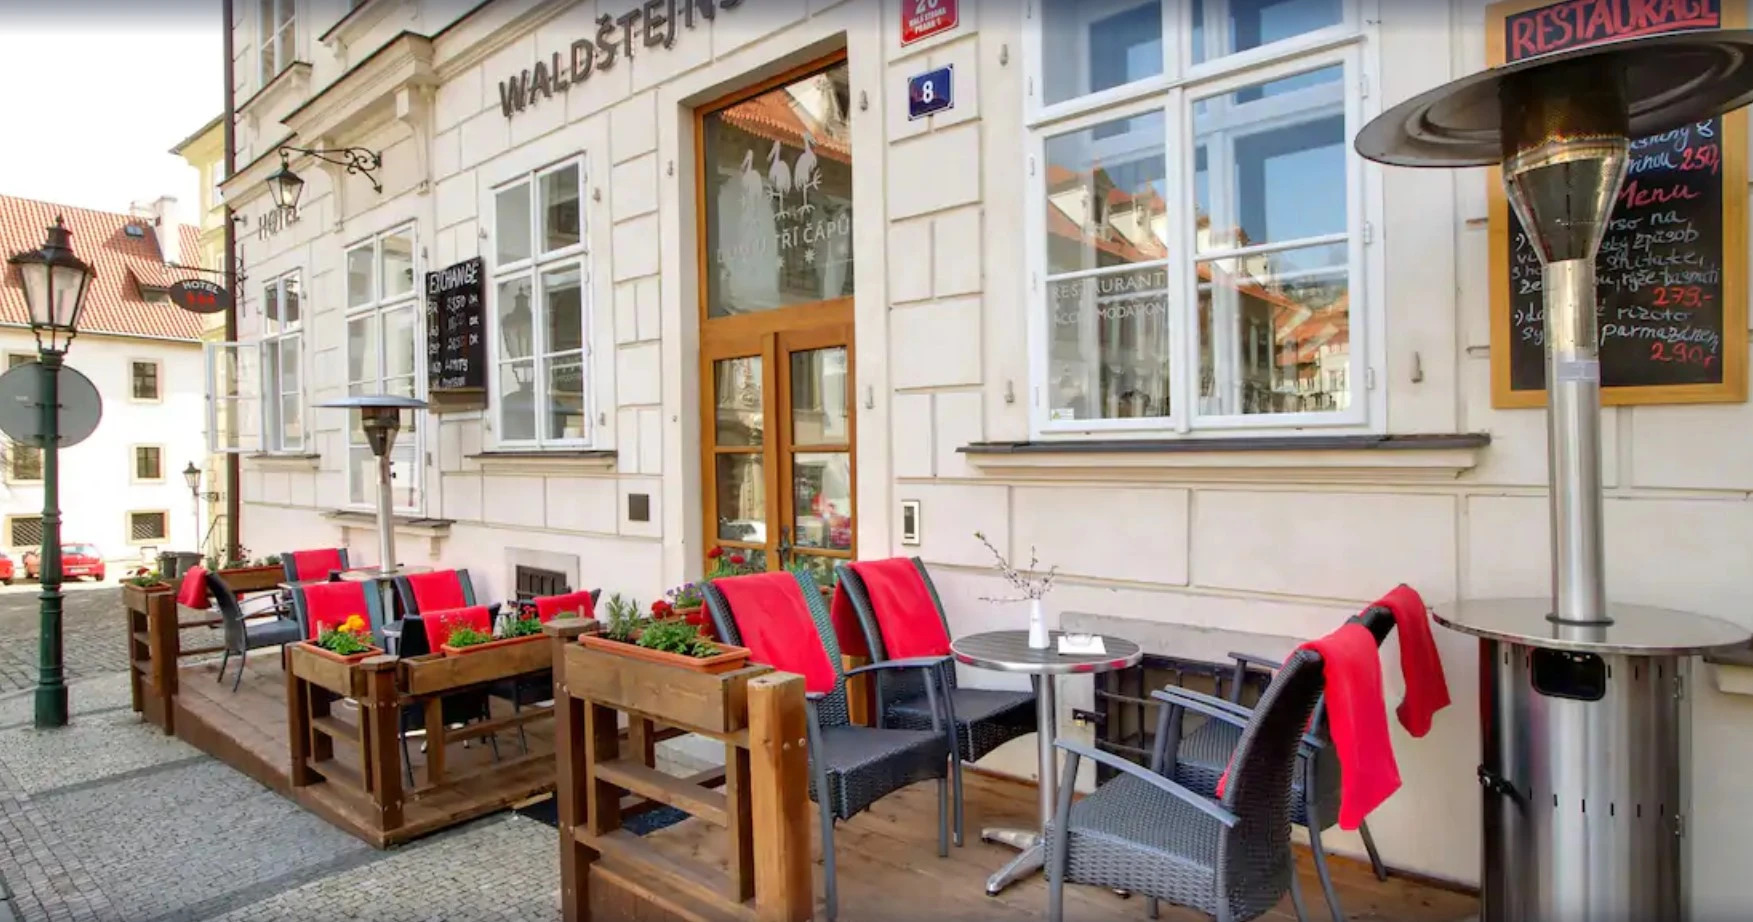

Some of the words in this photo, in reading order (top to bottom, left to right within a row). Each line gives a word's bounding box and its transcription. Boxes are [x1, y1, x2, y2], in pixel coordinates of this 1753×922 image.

[922, 80, 934, 104] 8
[258, 207, 300, 241] HOTEL
[182, 280, 219, 296] HOTEL
[429, 261, 480, 294] EXCHANGE
